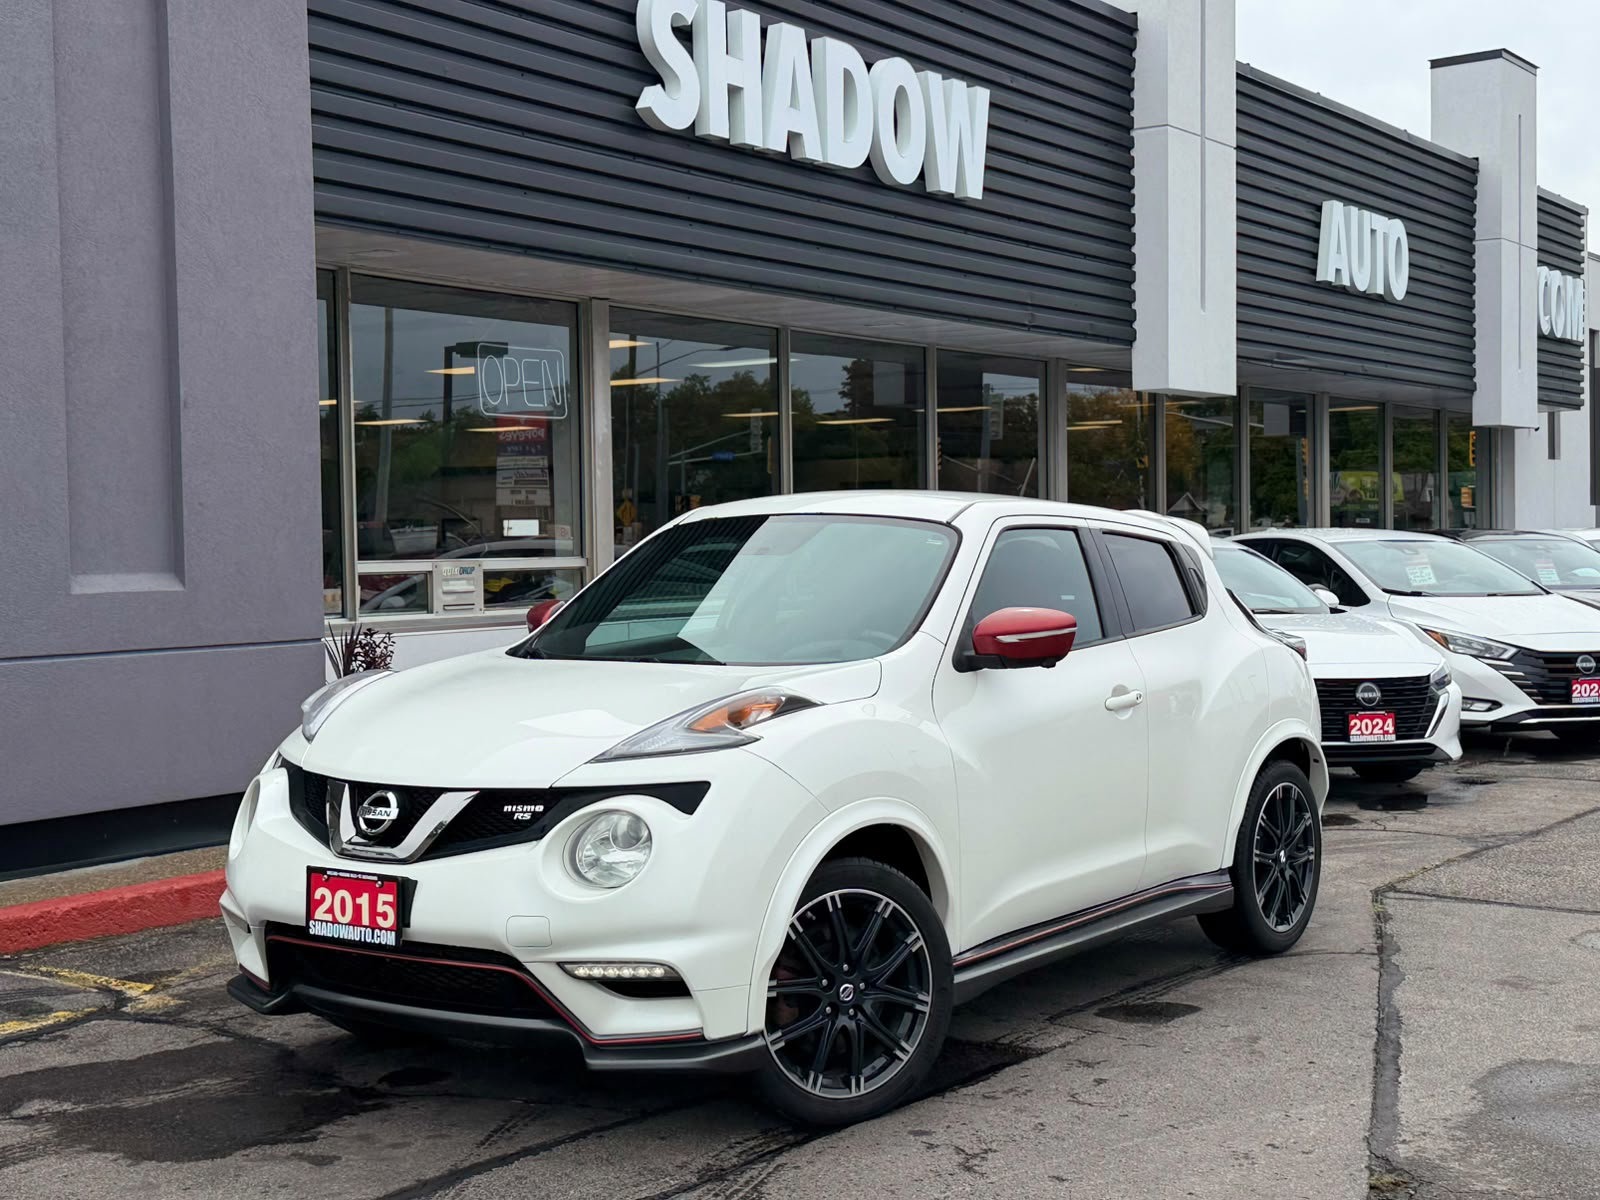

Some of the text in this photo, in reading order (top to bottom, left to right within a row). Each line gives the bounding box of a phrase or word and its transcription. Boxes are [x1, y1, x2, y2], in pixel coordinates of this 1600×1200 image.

[635, 0, 990, 199] SHADOW
[1316, 200, 1409, 301] AUTO
[481, 354, 562, 408] OPEN
[1572, 683, 1600, 697] 202
[1350, 718, 1394, 735] 2024
[358, 806, 393, 818] NISSAN
[513, 812, 532, 820] RS
[314, 887, 395, 928] 2015
[309, 920, 396, 946] SHADOWAUTO.COM
